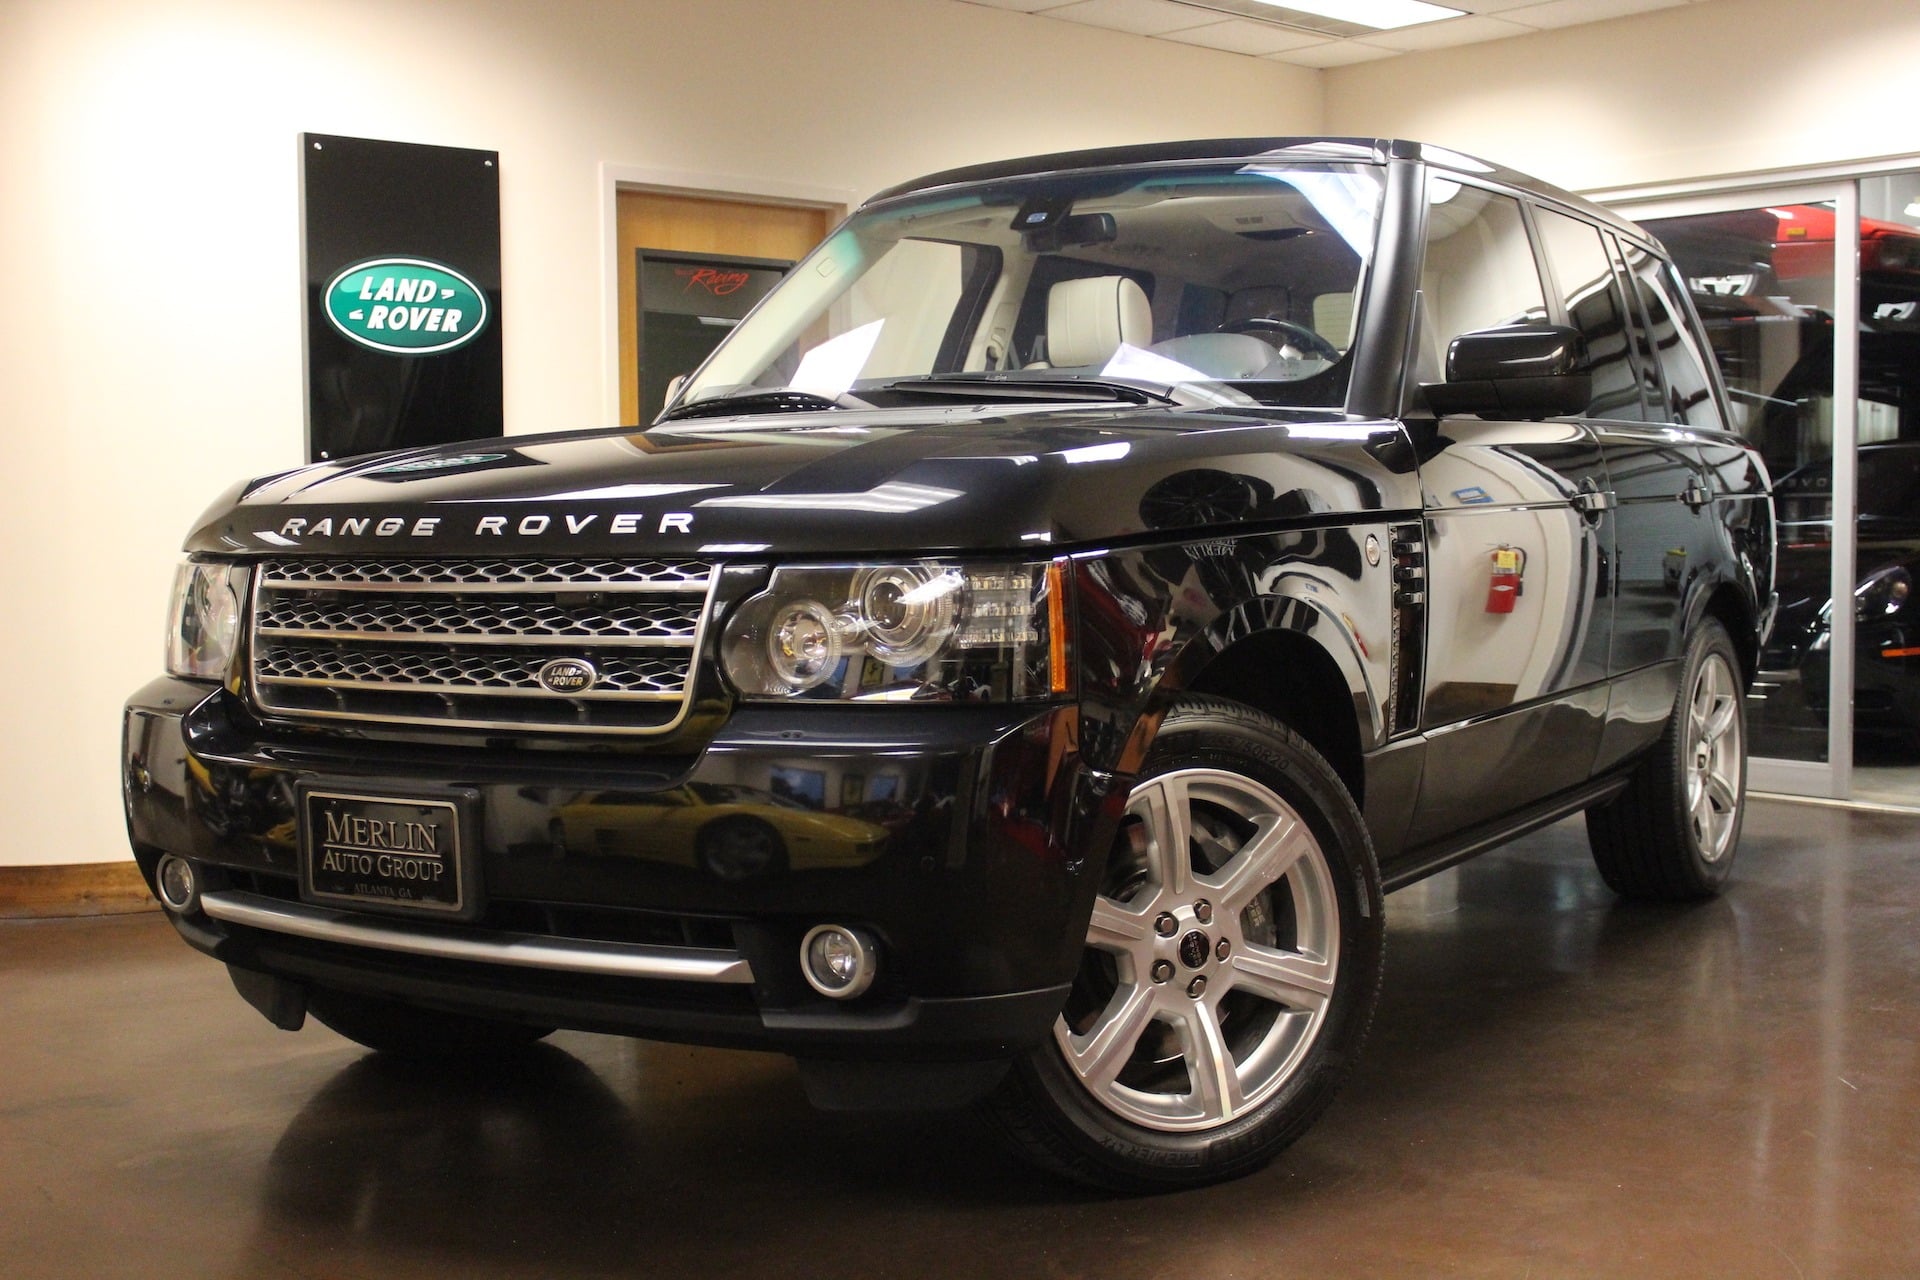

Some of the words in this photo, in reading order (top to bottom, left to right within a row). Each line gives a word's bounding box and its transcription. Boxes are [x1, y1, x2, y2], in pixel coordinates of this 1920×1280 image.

[359, 276, 438, 303] LAND
[366, 304, 463, 333] ROVER
[280, 516, 441, 537] RANGE
[474, 512, 695, 536] ROVER
[550, 666, 577, 677] LAND
[552, 676, 584, 686] ROVER
[324, 812, 438, 851] MERLIN
[322, 849, 372, 875] AUTO
[377, 855, 444, 882] GROUP
[399, 888, 412, 898] GA
